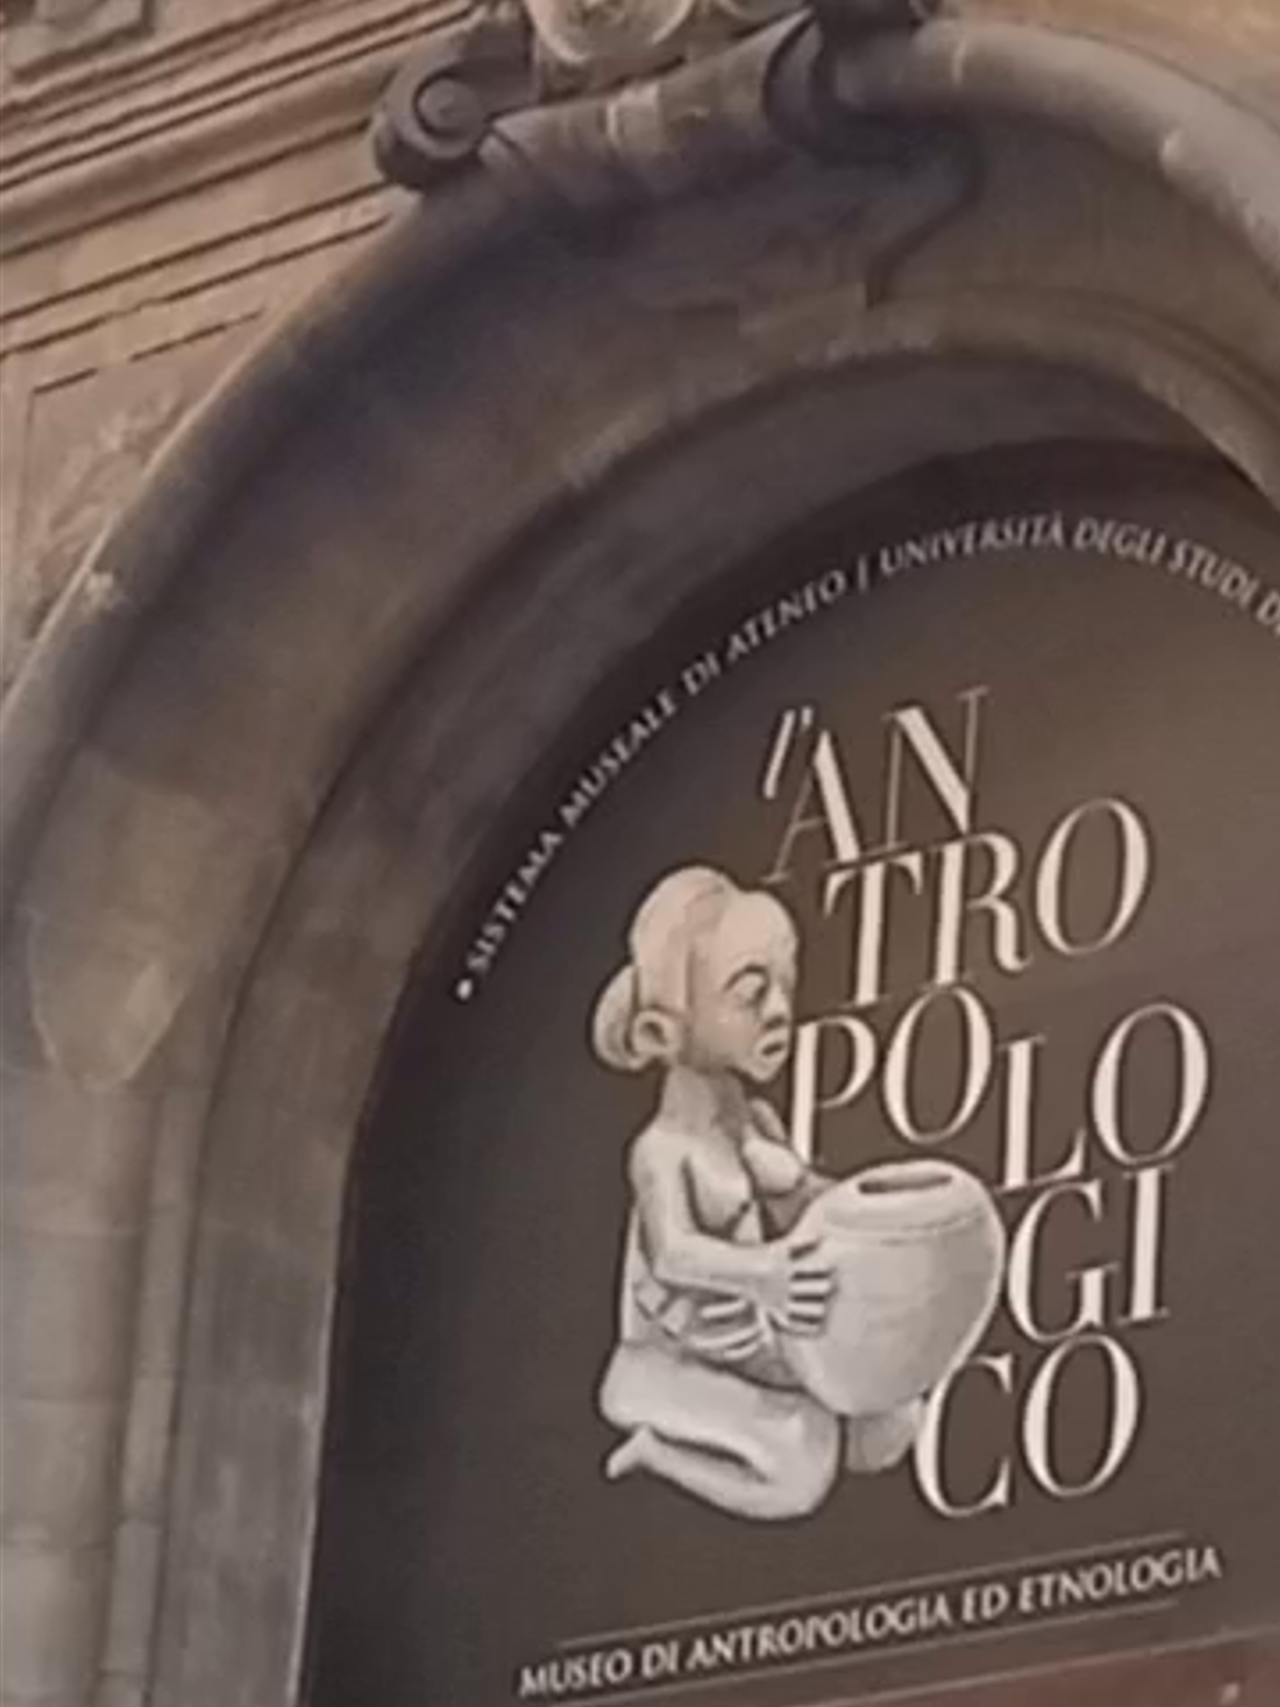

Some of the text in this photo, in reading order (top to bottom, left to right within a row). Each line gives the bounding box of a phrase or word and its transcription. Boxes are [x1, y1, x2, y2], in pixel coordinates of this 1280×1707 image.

[466, 830, 564, 974] SISTEMA
[560, 690, 679, 829] MUSEALE
[681, 651, 720, 695] DI
[726, 569, 846, 663] ATENEO
[879, 511, 1064, 577] UNIVERSITÀ
[1072, 517, 1167, 566] DEGLI
[1167, 539, 1258, 610] STUDI
[823, 797, 1150, 1009] TRO
[791, 984, 1209, 1191] POLO
[1007, 1163, 1172, 1343] GI
[914, 1333, 1140, 1518] CO
[519, 1546, 1223, 1697] MUSEO DI ANTROPOLOGIA ED ETNOLOGIA
